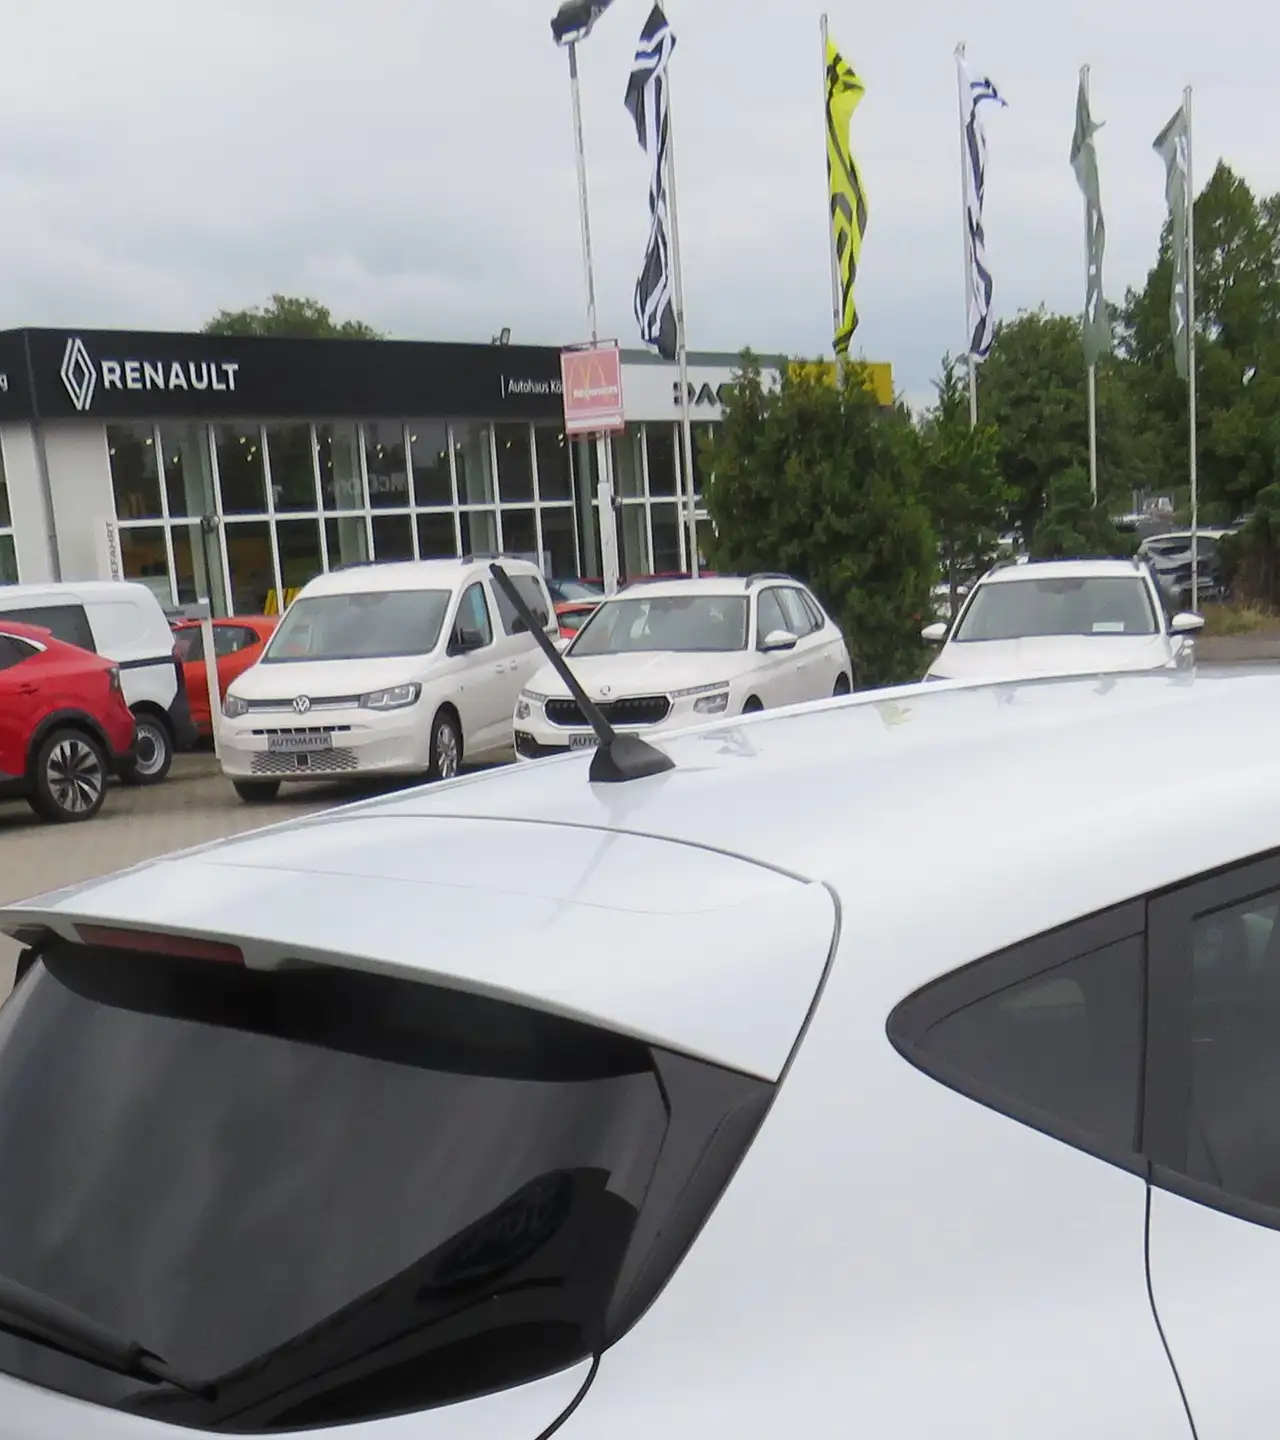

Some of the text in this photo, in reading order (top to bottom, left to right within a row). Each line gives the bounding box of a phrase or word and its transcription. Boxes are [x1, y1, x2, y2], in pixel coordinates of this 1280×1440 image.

[101, 360, 240, 391] RENAULT
[508, 378, 562, 394] Autohaus Kö
[271, 736, 330, 748] AUTOMATIK
